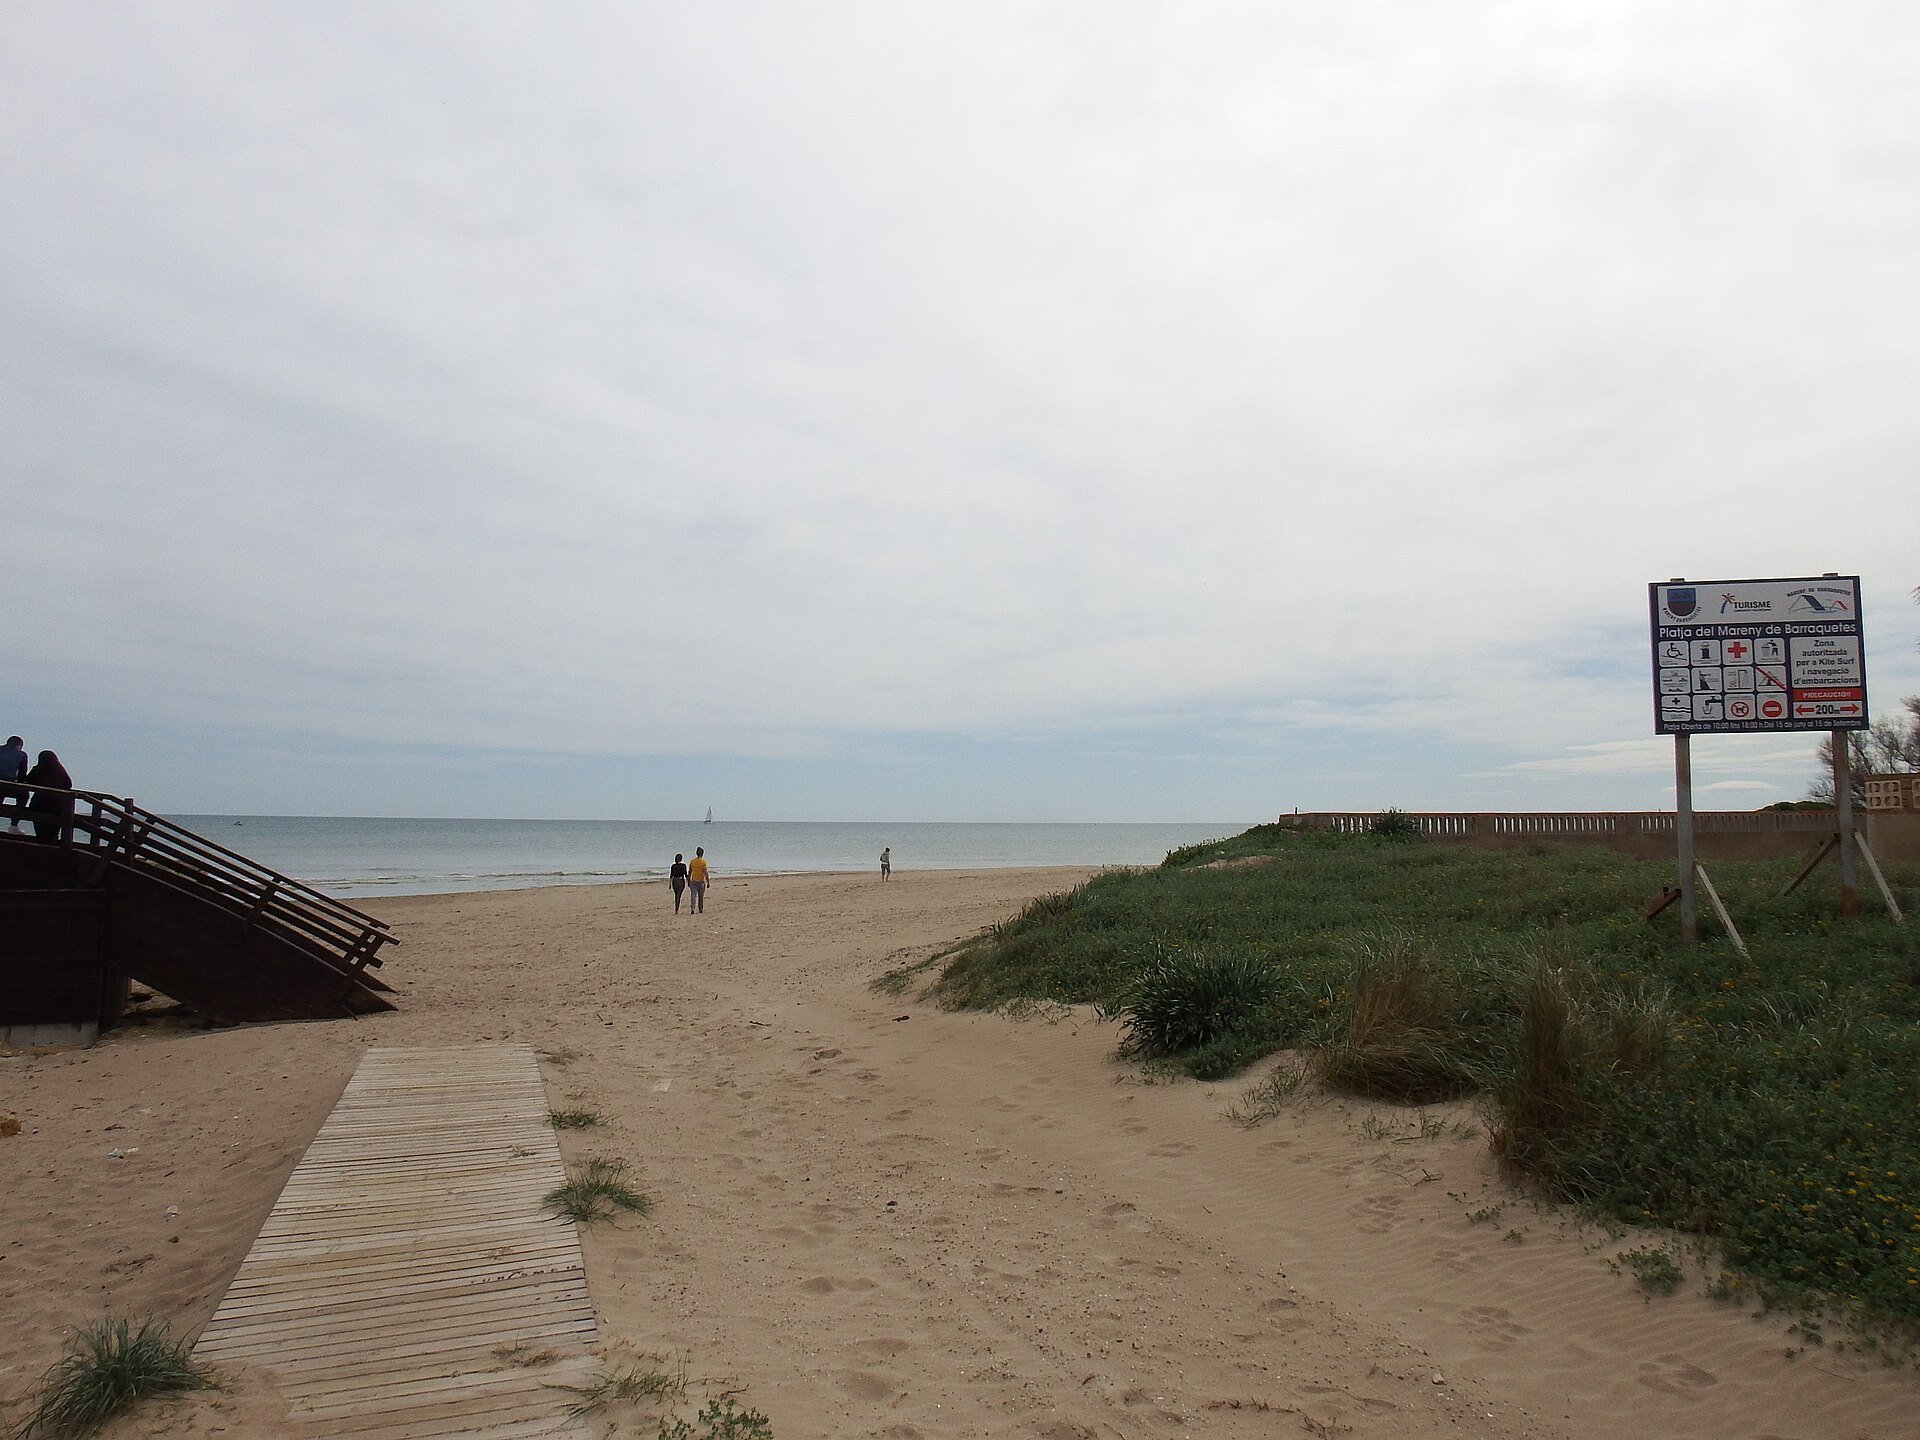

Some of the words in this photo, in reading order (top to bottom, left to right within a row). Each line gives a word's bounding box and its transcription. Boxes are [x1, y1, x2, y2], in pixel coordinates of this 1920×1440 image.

[1659, 627, 1691, 639] Platja
[1695, 626, 1714, 637] del
[1718, 625, 1762, 637] Mareny
[1765, 625, 1782, 635] de
[1785, 624, 1856, 635] Barraquetes
[1837, 657, 1855, 665] Surf
[1808, 668, 1849, 676] navegació
